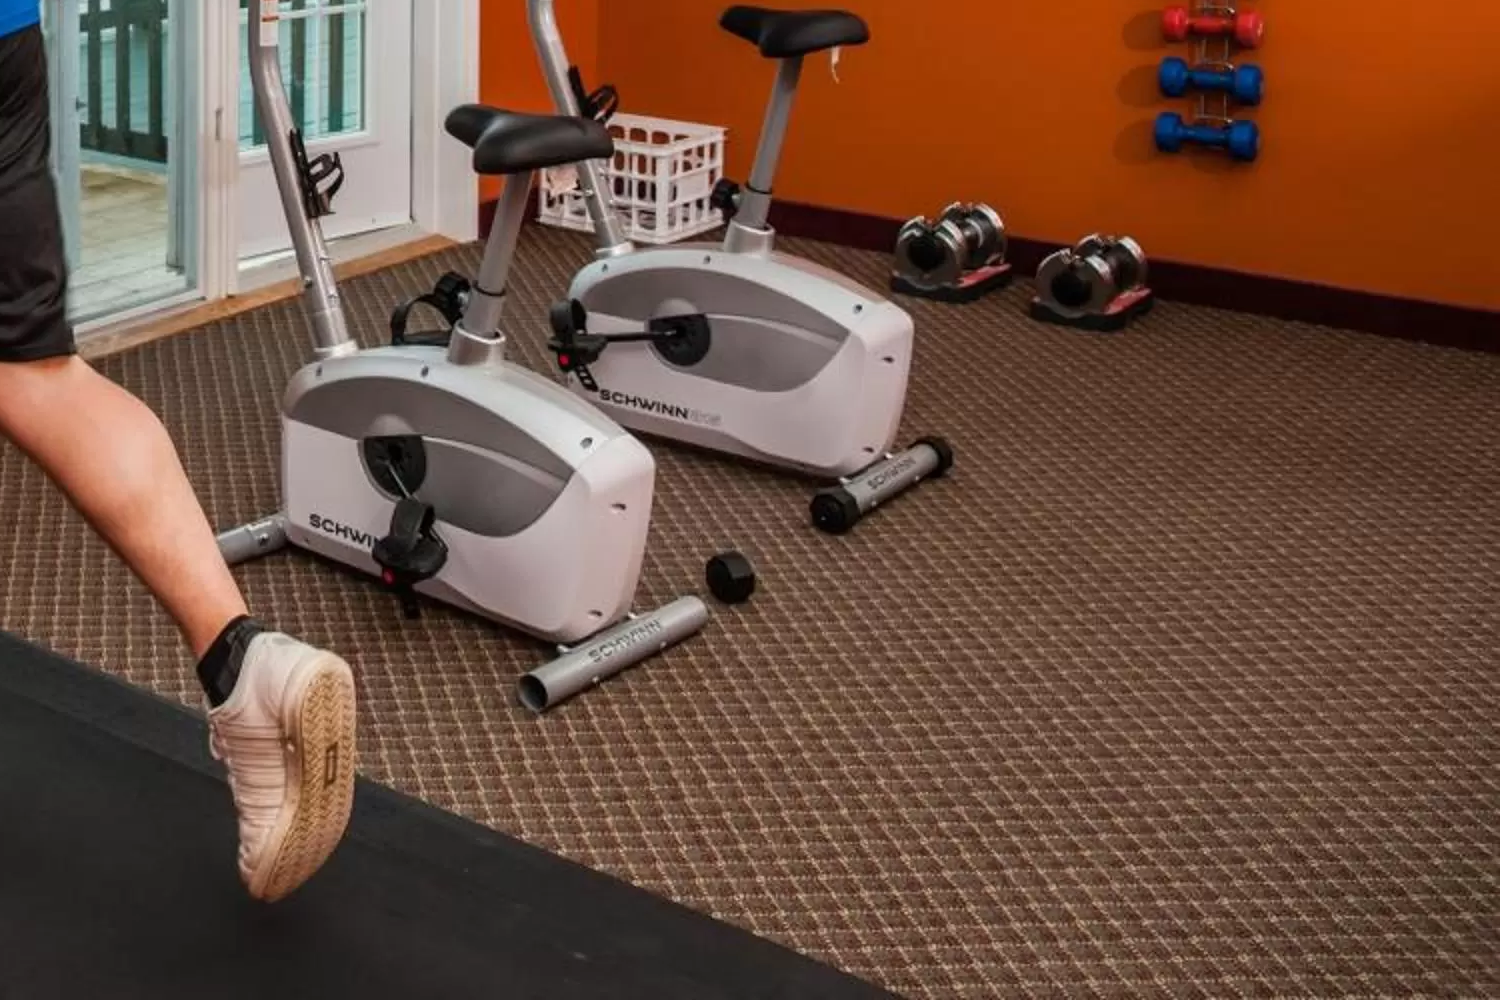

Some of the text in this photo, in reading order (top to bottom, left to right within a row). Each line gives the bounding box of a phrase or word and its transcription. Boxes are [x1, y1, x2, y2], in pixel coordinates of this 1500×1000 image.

[599, 389, 688, 419] SCHWINN
[309, 513, 381, 548] SCHWI
[587, 618, 661, 662] SCHWINN
